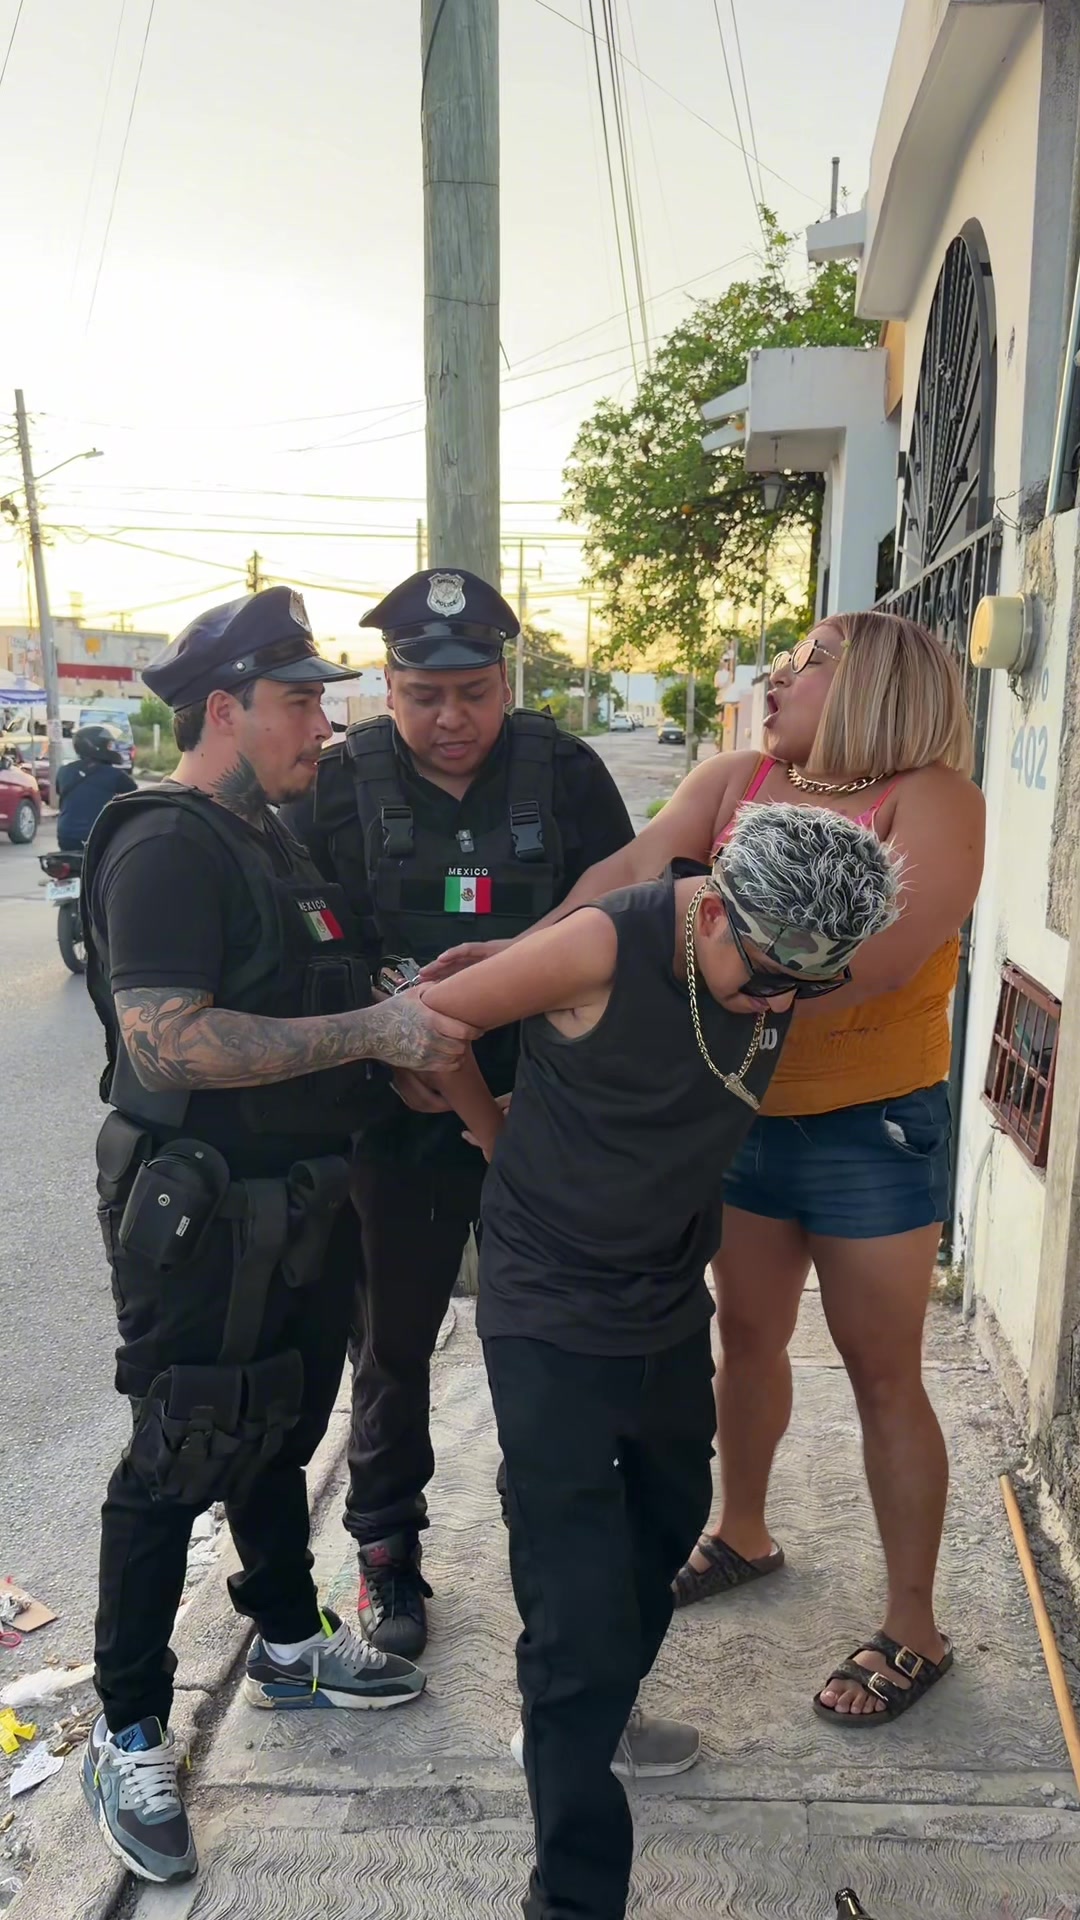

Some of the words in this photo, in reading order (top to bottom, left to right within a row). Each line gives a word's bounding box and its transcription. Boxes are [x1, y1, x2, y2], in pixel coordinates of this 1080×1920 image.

[435, 599, 457, 608] POLICE
[1010, 724, 1048, 790] 402
[448, 867, 489, 876] MEXICO
